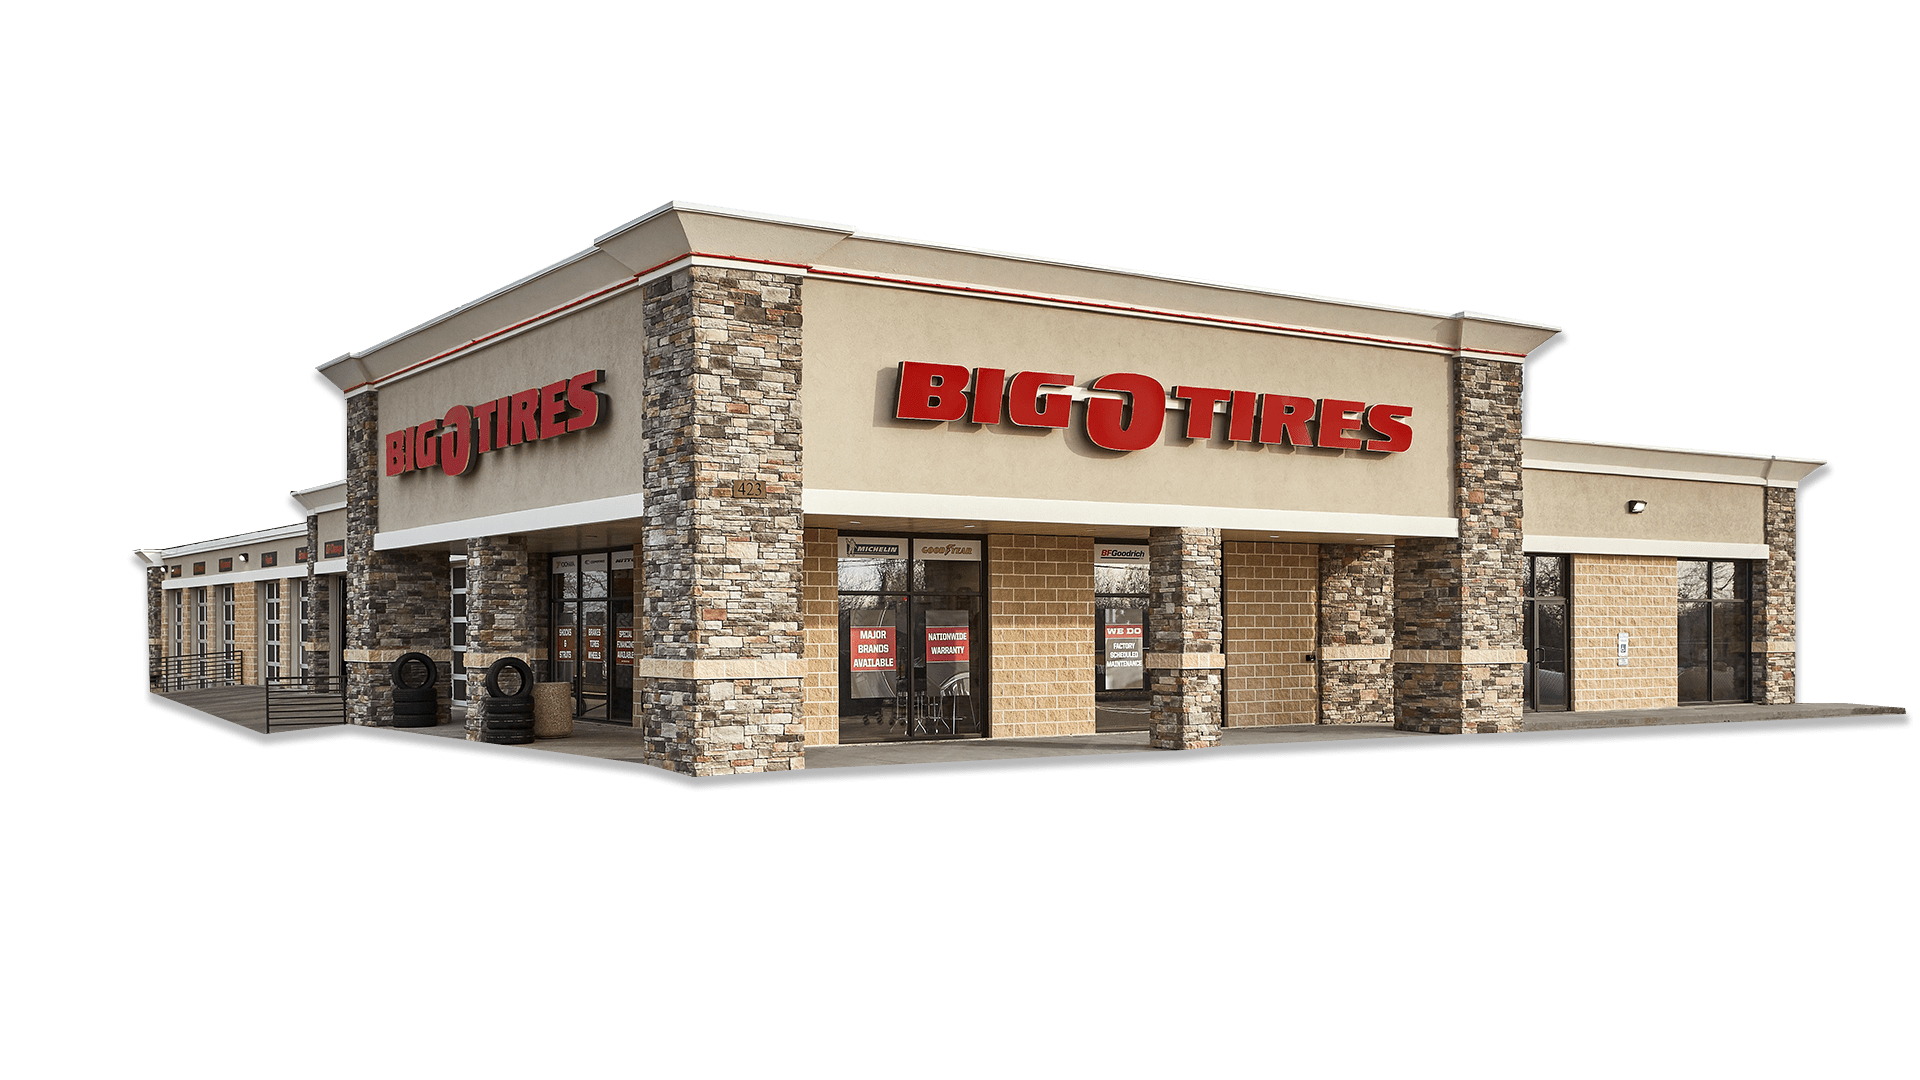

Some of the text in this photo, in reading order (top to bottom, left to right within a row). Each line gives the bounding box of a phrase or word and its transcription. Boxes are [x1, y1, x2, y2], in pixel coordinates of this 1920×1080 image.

[895, 360, 1414, 454] BIG O TIRES
[385, 369, 603, 477] BIG O TIRES
[737, 482, 762, 496] 423
[856, 545, 898, 553] MICHELIN
[921, 545, 973, 555] GOODYEAR
[1101, 549, 1145, 558] BFGoodrich
[860, 630, 887, 640] MAJOR
[1106, 627, 1142, 635] WE DO
[928, 632, 967, 641] NATIONWIDE
[857, 644, 889, 654] BRANDS
[931, 646, 965, 655] WARRANTY
[1113, 642, 1135, 650] FACTORY
[1110, 651, 1139, 659] SCHEDULED
[853, 658, 894, 668] AVAILABLE
[1106, 660, 1143, 668] MAINTENANCE
